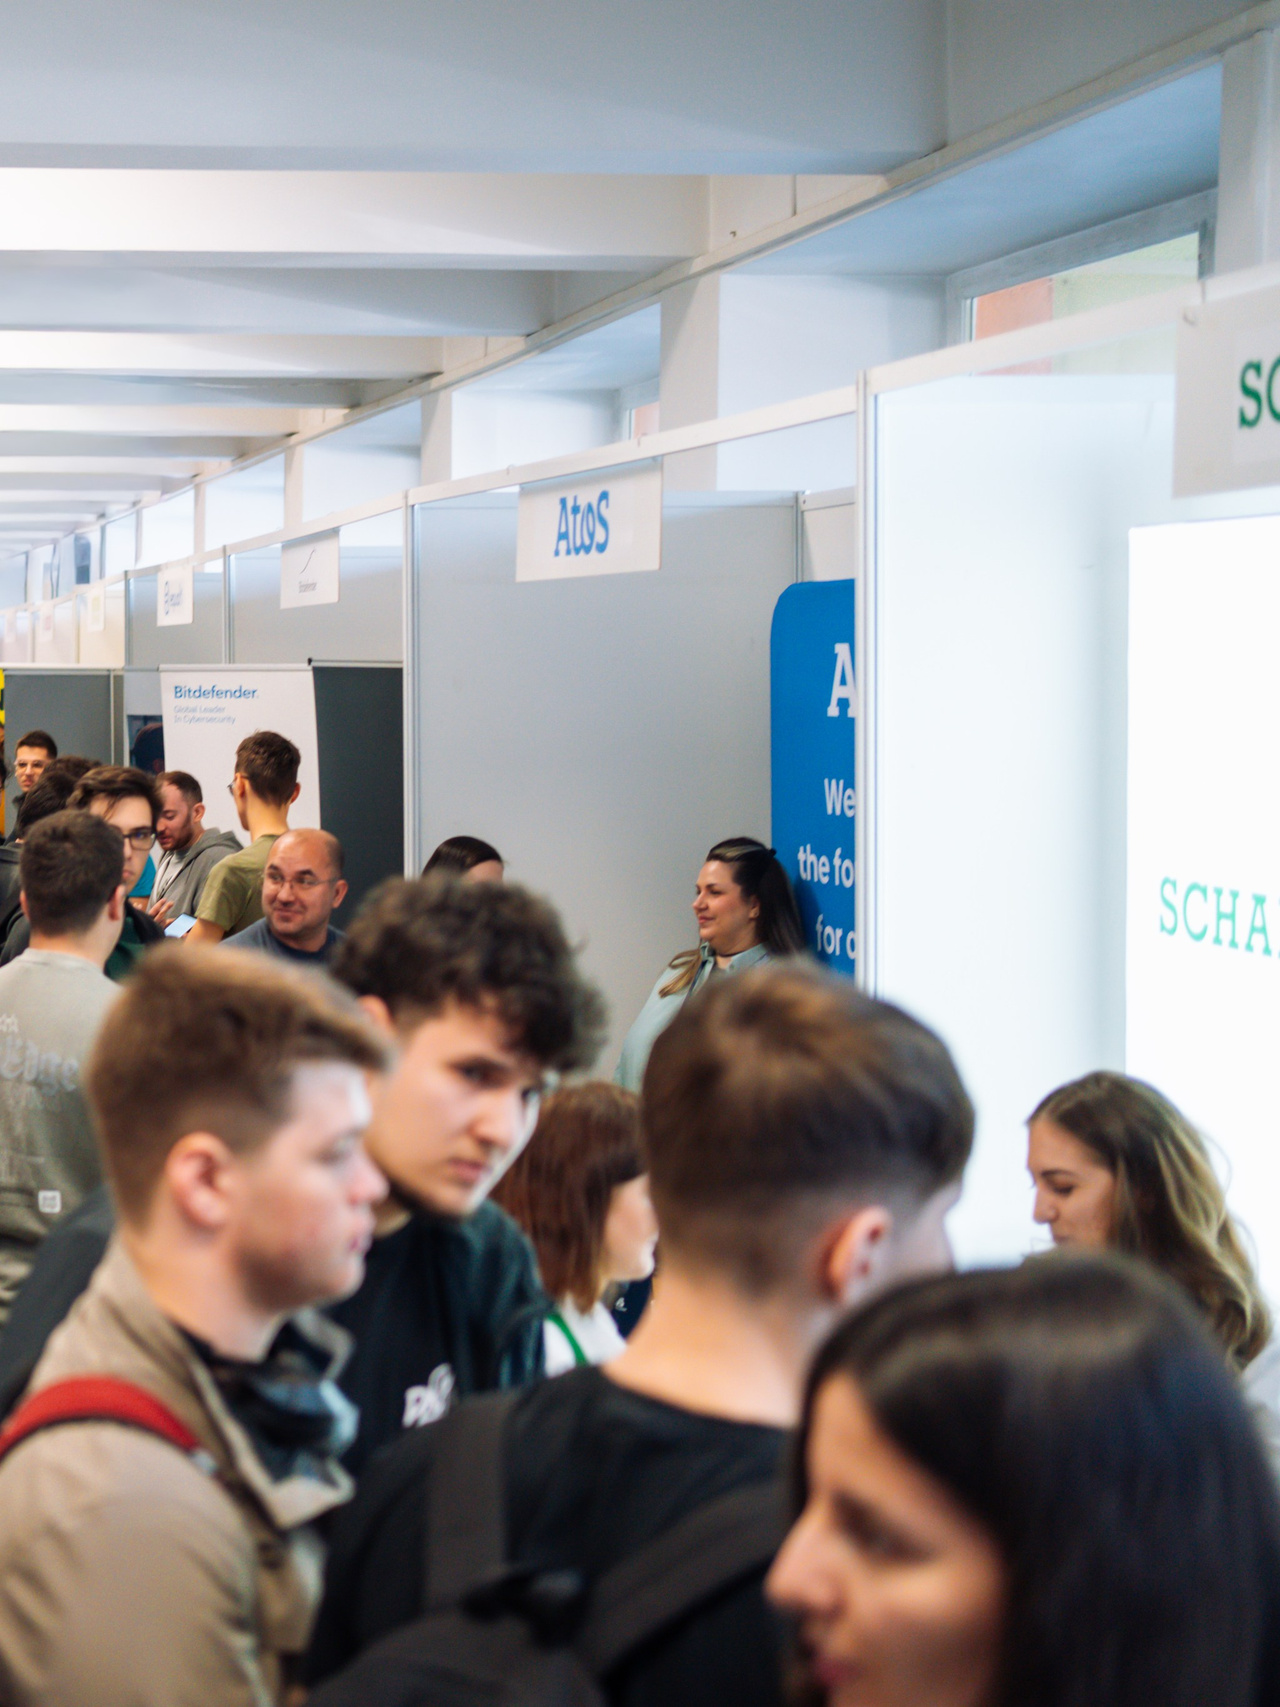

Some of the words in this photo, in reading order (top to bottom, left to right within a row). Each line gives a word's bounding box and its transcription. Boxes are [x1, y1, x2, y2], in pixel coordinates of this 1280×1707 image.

[174, 685, 257, 699] Bitdefender
[824, 778, 856, 817] We
[798, 844, 830, 884] the
[816, 914, 843, 956] for
[1159, 876, 1280, 958] SCHA
